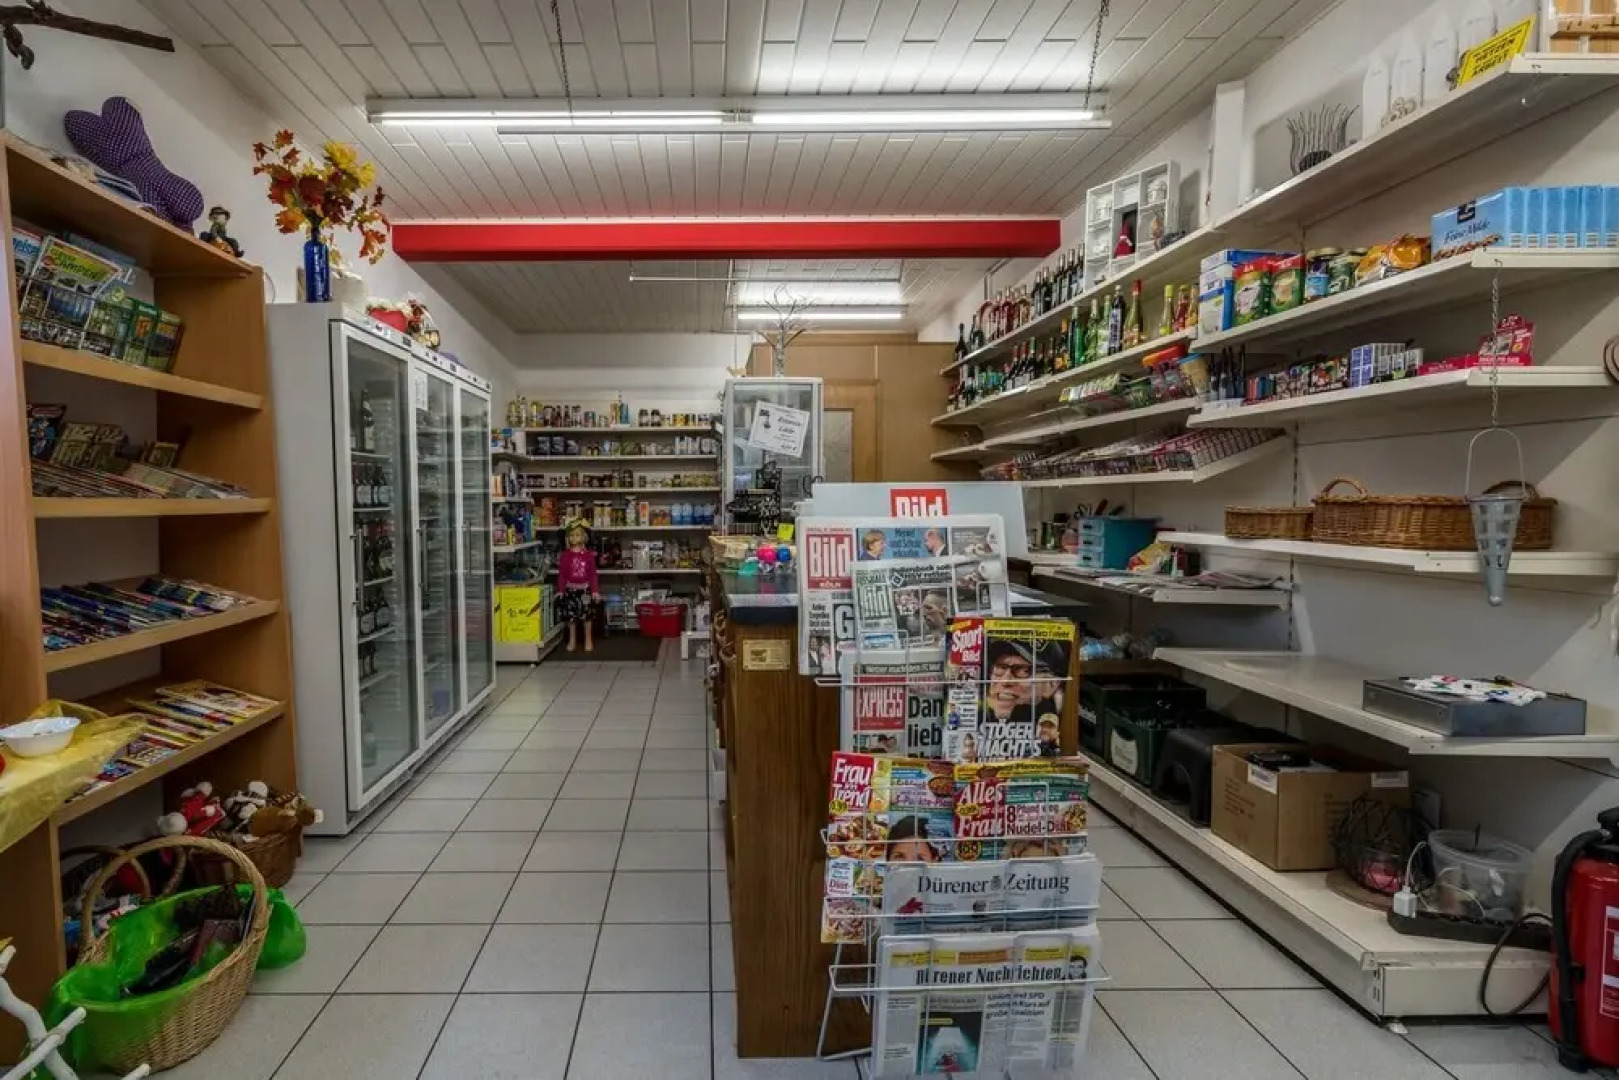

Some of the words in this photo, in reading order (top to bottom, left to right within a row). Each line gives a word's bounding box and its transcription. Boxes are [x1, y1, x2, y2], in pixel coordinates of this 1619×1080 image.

[808, 536, 852, 577] Bild
[951, 626, 982, 652] Sport
[962, 650, 980, 661] Bild
[856, 686, 904, 718] EXPRESS
[834, 758, 873, 783] Frau
[833, 784, 872, 807] Trend
[959, 781, 1003, 803] Alles
[1007, 806, 1016, 823] 8
[957, 815, 1005, 838] Frau
[917, 875, 988, 894] Dürener
[1004, 873, 1070, 894] Zeitung
